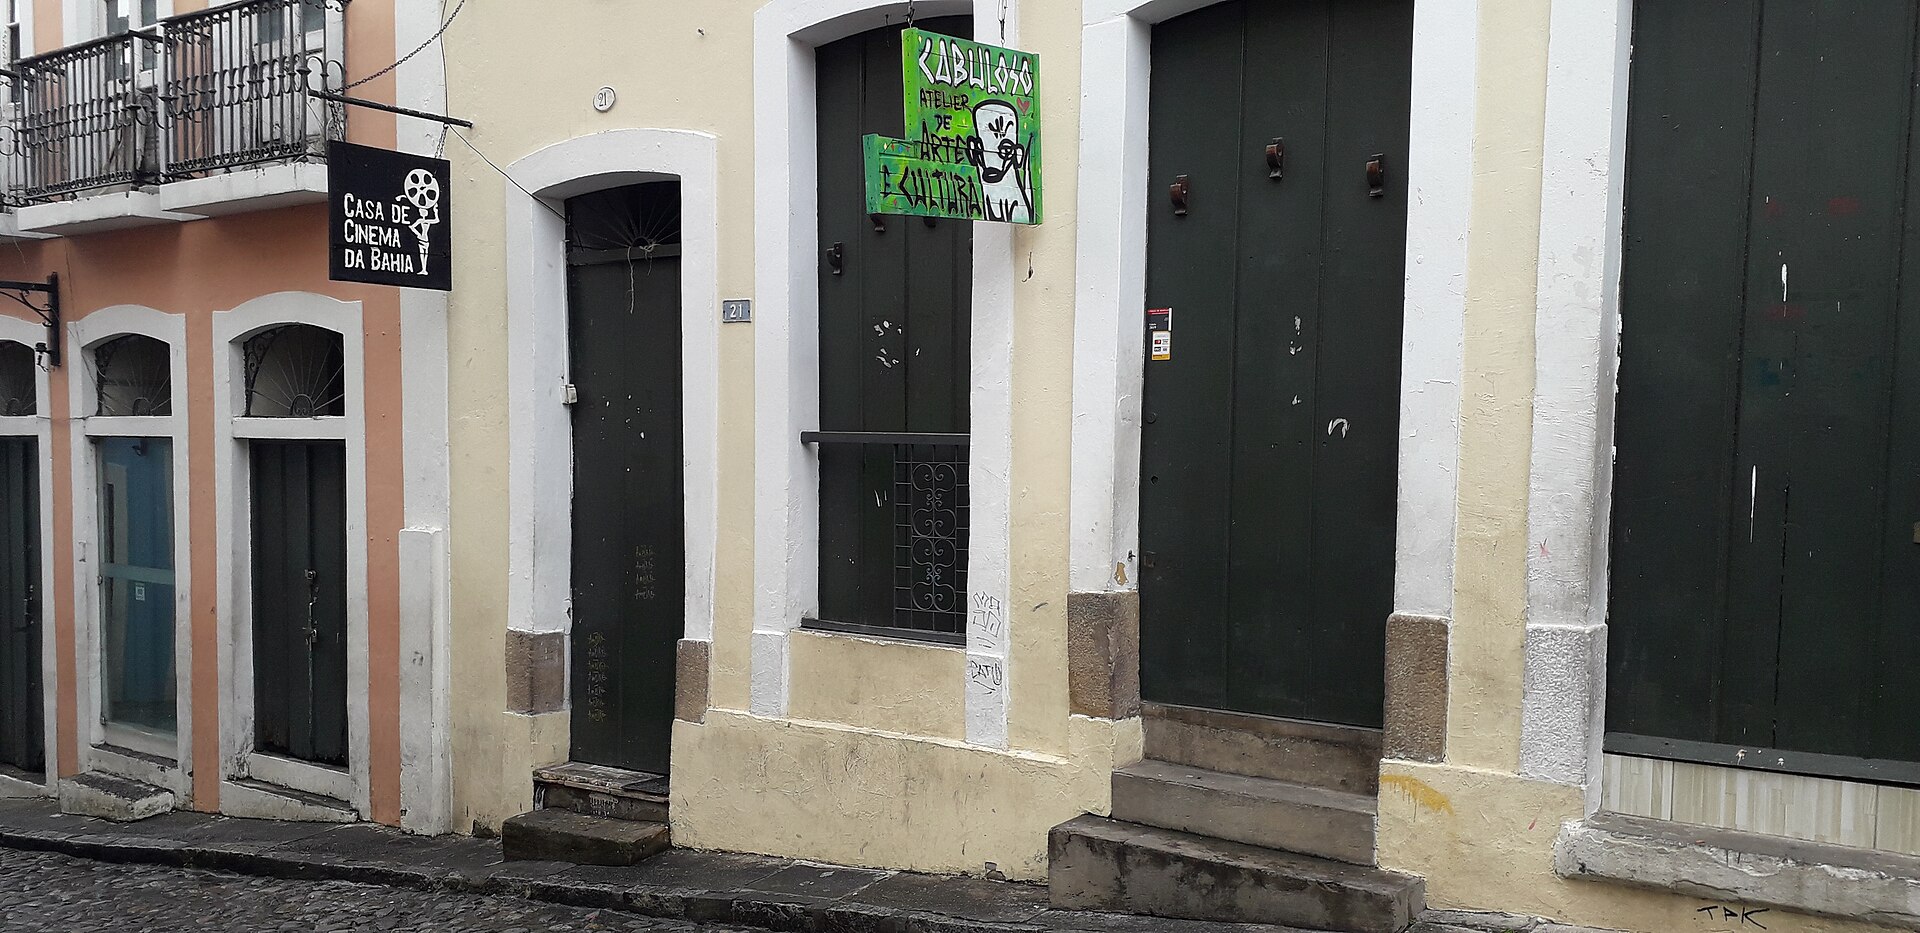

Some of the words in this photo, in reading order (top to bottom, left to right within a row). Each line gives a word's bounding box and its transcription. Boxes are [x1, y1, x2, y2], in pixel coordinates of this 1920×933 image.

[918, 37, 1034, 96] CABULOSO
[598, 92, 607, 107] 21
[919, 87, 972, 111] ATELIER
[934, 114, 953, 132] DE
[920, 119, 968, 165] ARTE
[899, 166, 983, 217] CULTURA
[344, 193, 385, 222] CASA
[391, 203, 412, 225] DE
[344, 218, 401, 248] CINEMA
[344, 248, 366, 270] DA
[370, 246, 414, 273] BAHIA
[730, 303, 742, 318] 21
